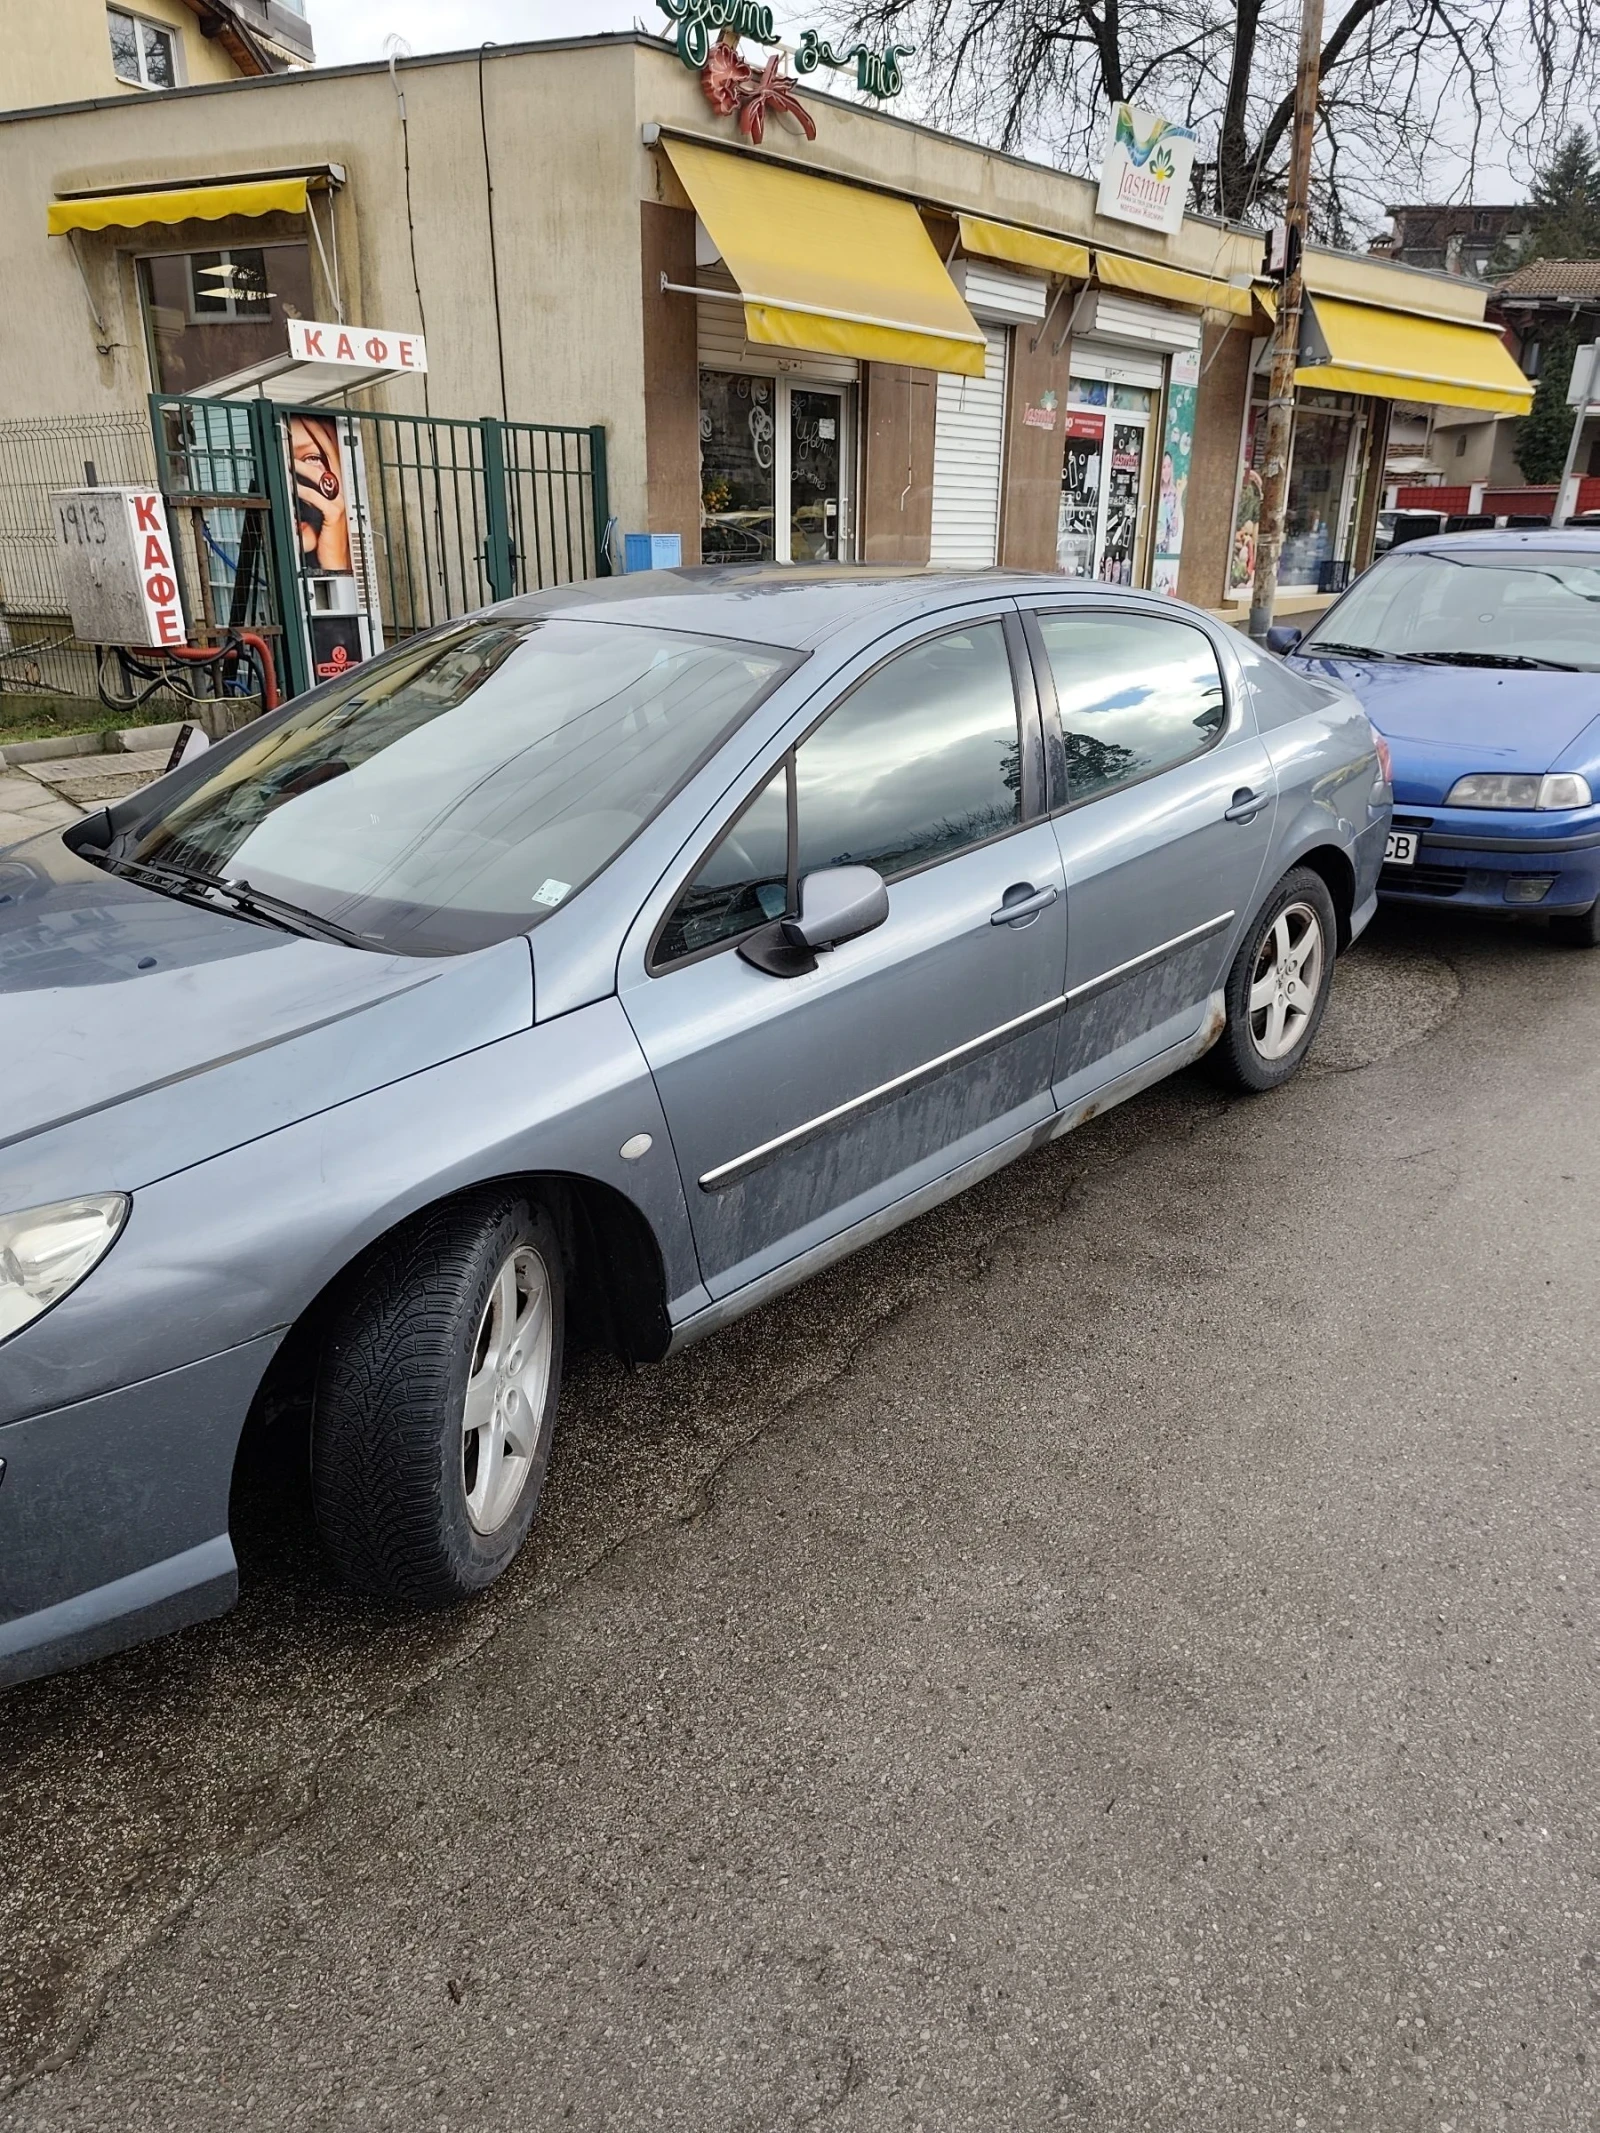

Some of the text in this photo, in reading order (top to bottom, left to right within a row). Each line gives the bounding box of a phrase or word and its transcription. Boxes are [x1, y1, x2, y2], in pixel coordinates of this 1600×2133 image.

[1116, 162, 1171, 206] Jasmin
[304, 328, 414, 367] КАФЕ
[60, 503, 107, 545] 1913
[134, 496, 181, 644] КАФЕ
